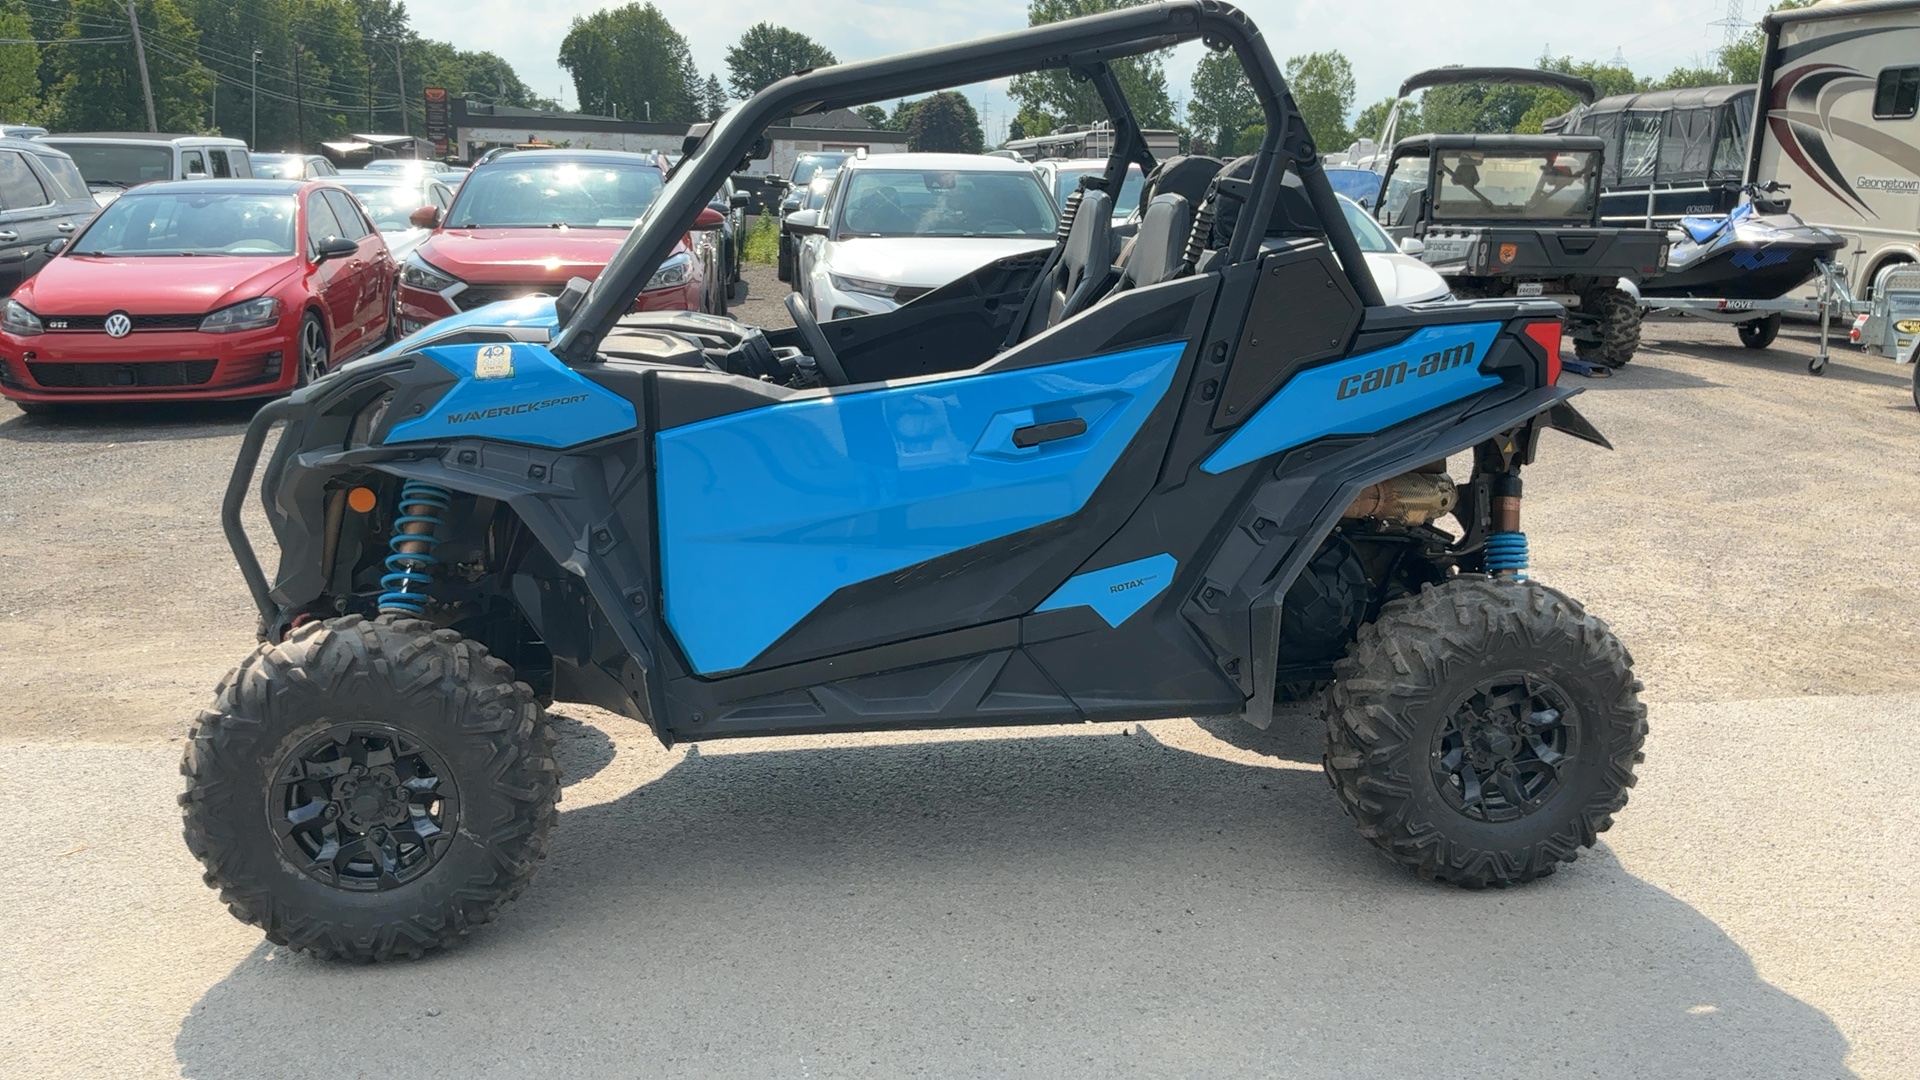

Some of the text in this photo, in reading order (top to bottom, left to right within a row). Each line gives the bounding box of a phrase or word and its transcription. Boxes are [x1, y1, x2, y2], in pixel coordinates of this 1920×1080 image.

[1857, 176, 1920, 191] Georgetown
[1726, 300, 1753, 309] MOVE
[1336, 341, 1475, 401] can-am
[447, 394, 589, 424] MAVERICK SPORT
[1109, 578, 1144, 594] ROTAX
